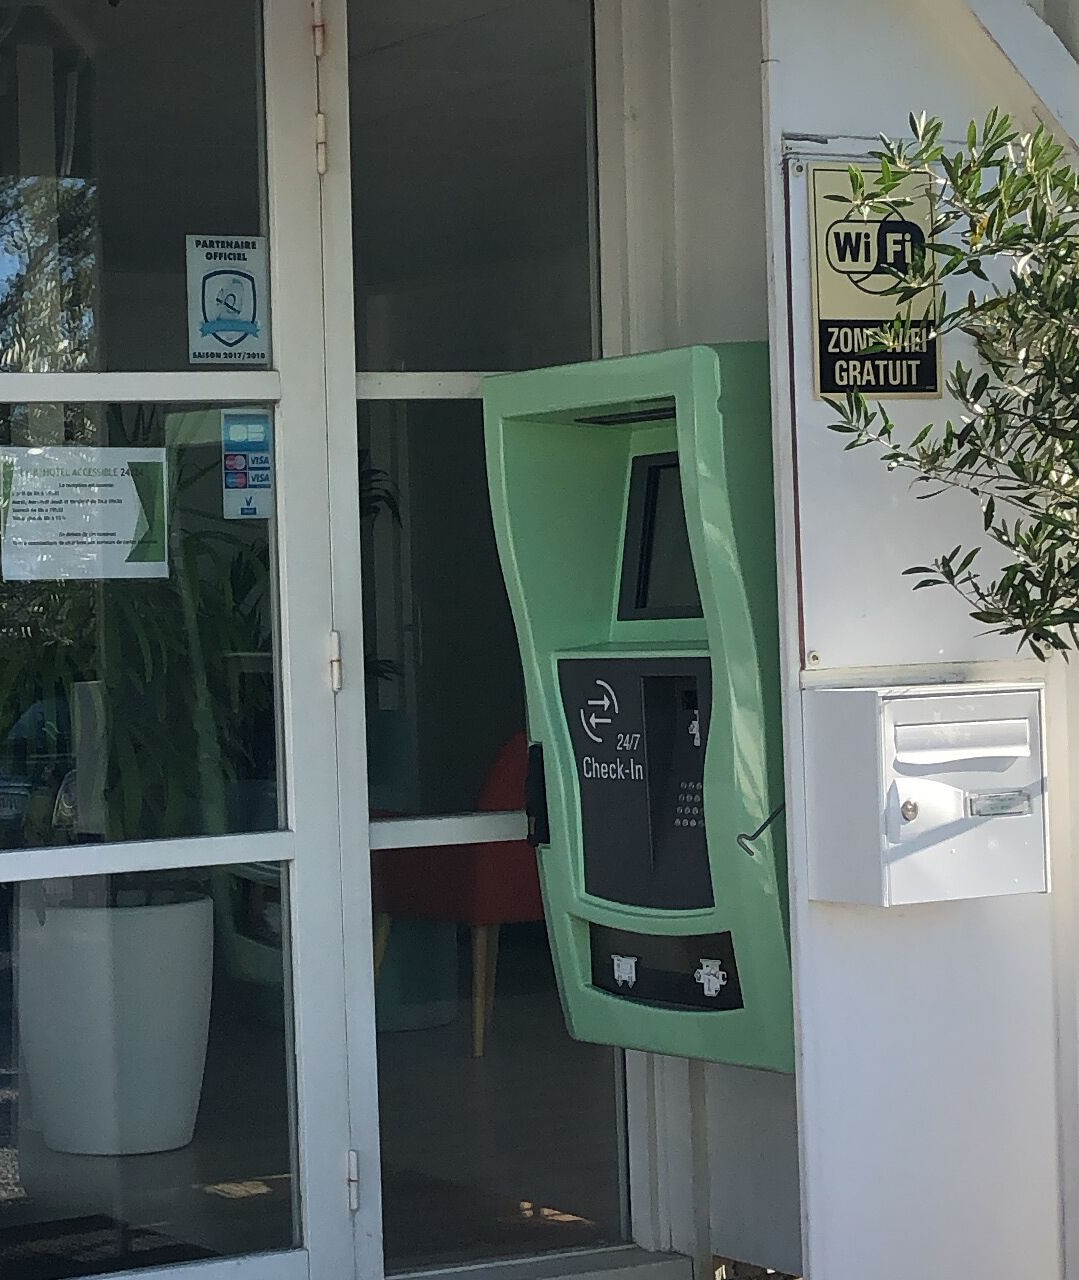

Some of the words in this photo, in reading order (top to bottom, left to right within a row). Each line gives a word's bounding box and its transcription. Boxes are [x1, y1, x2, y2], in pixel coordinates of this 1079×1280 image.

[195, 240, 257, 249] PARTENAIRE
[205, 251, 247, 261] OFFICIEL
[192, 351, 222, 359] SAISON
[834, 360, 921, 386] GRATUIT
[251, 456, 270, 465] VISA
[251, 473, 270, 483] VISA
[616, 733, 641, 751] 24/7
[583, 756, 643, 780] Check-In
